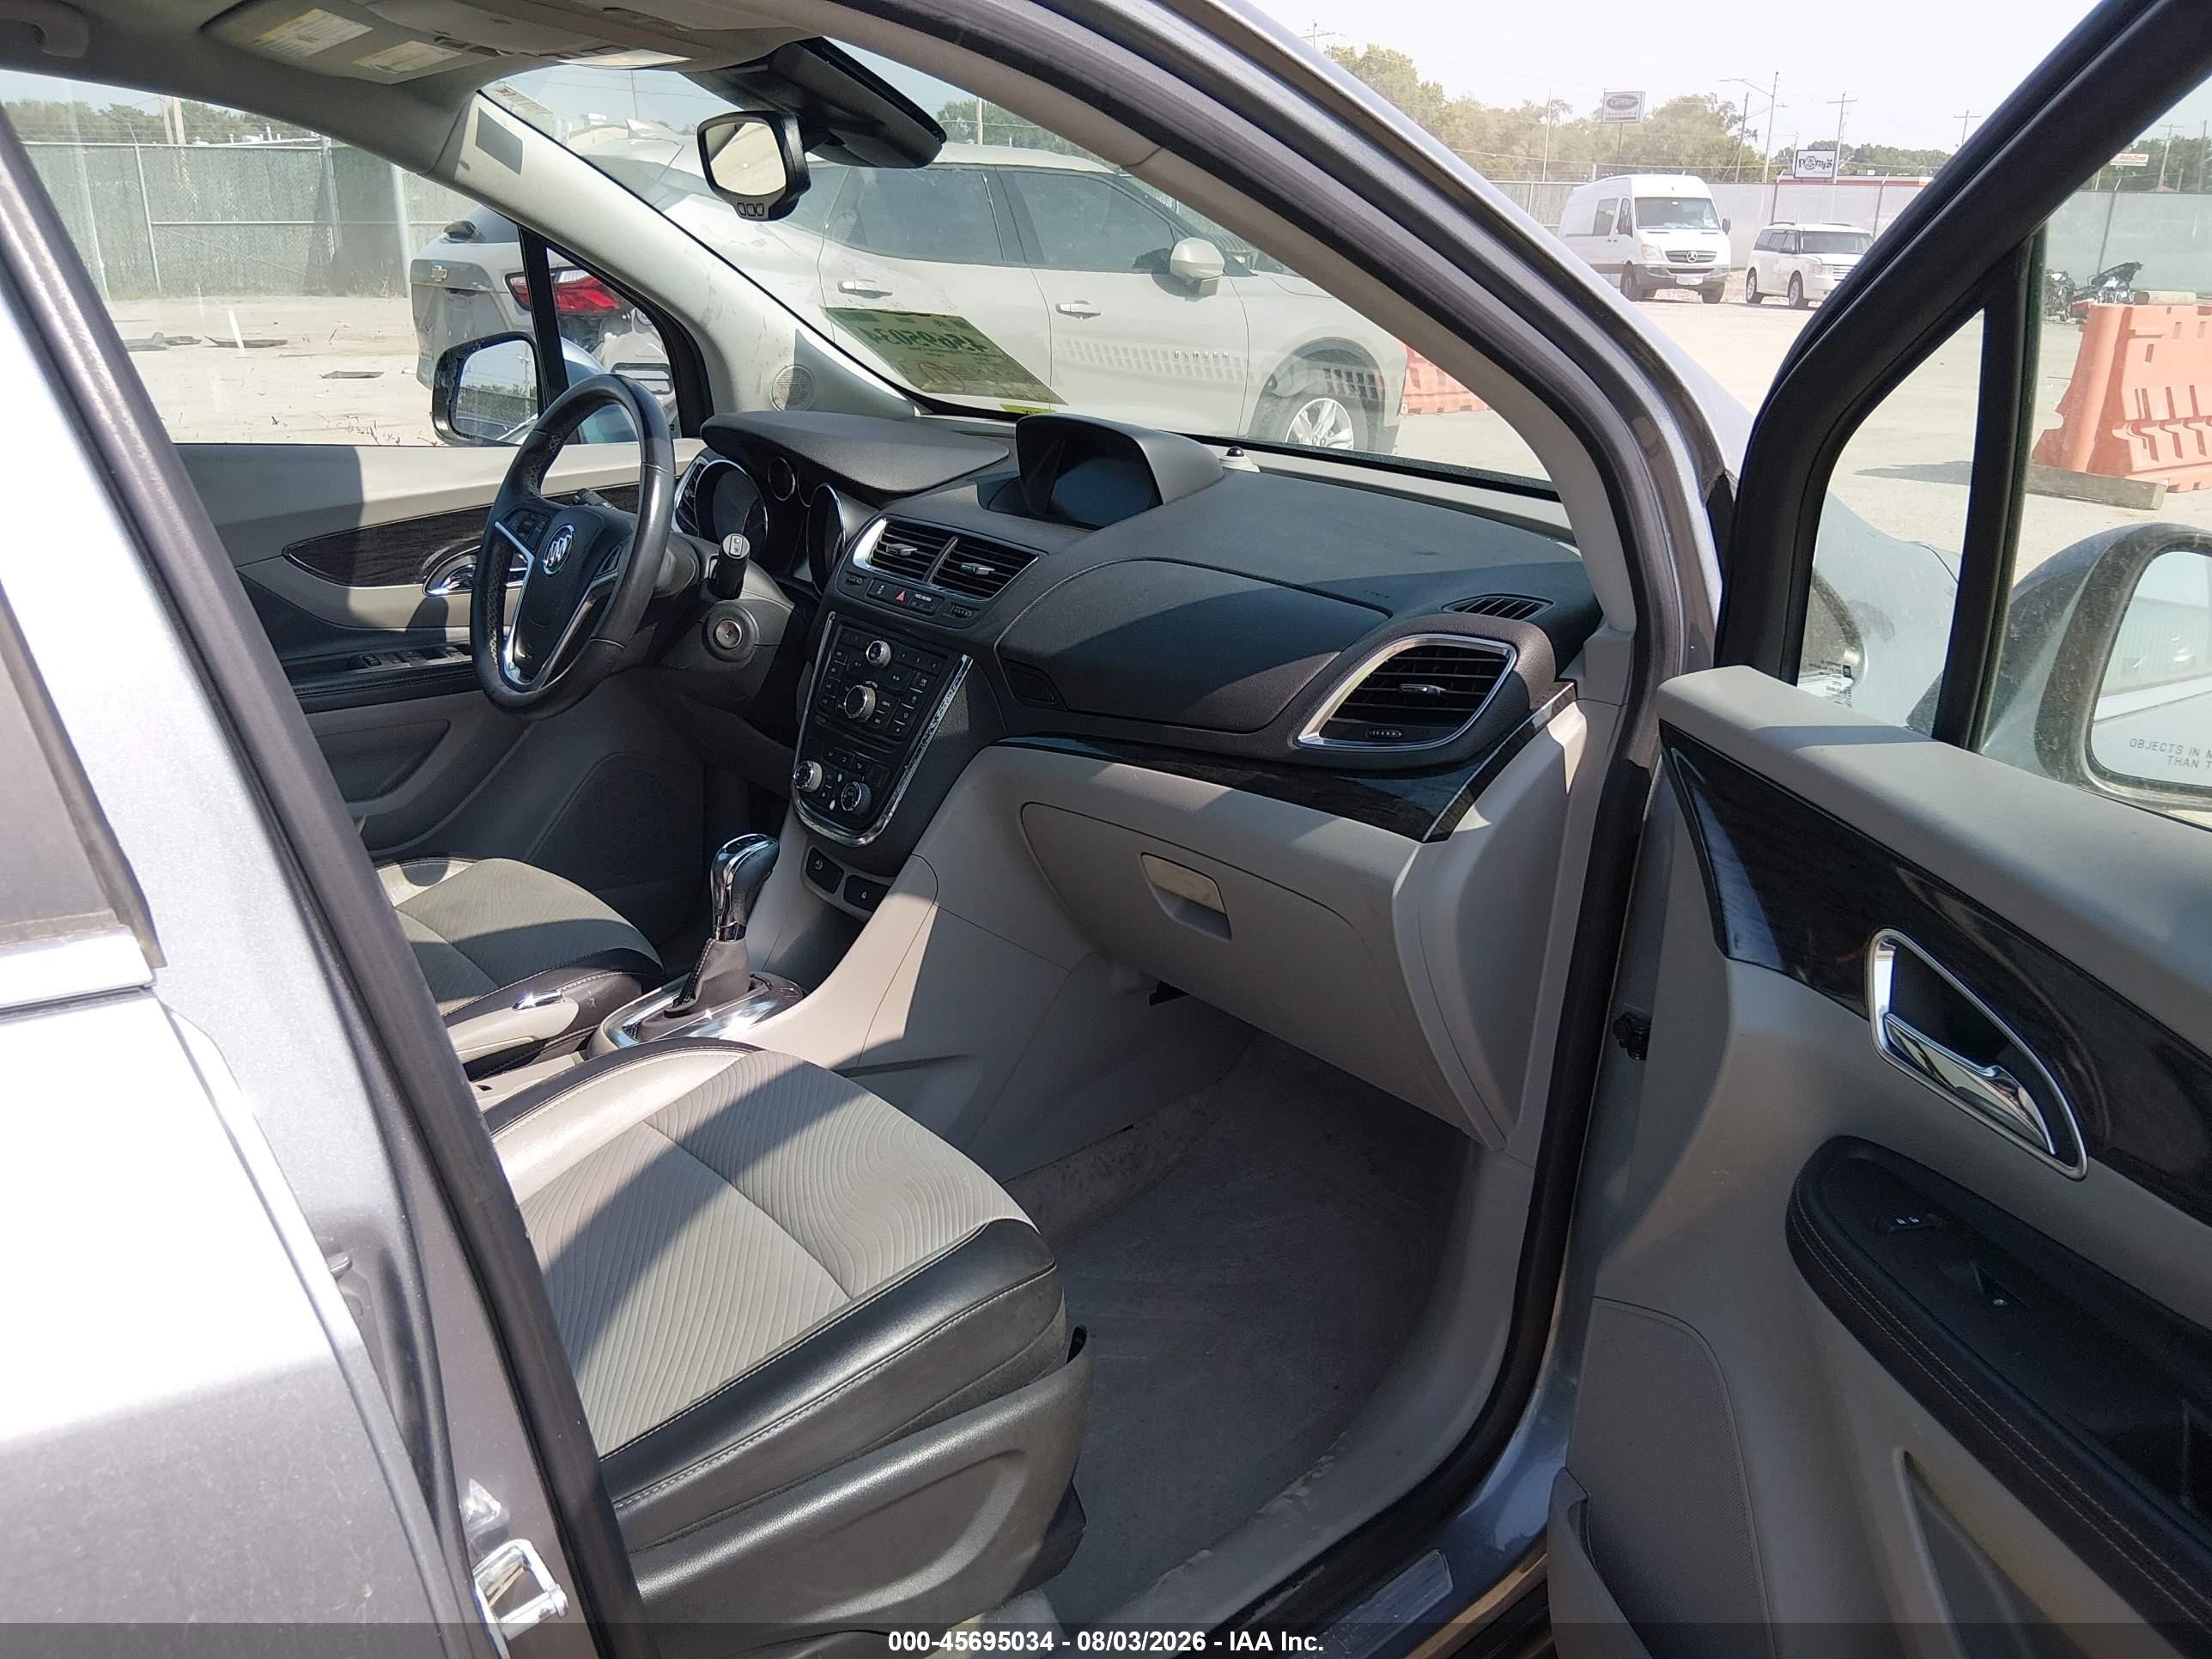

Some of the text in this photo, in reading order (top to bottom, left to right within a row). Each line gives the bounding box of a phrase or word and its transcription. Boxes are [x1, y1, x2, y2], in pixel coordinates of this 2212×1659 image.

[2129, 738, 2184, 755] OBJECTS
[2189, 747, 2200, 757] IN
[2166, 755, 2199, 769] THAN
